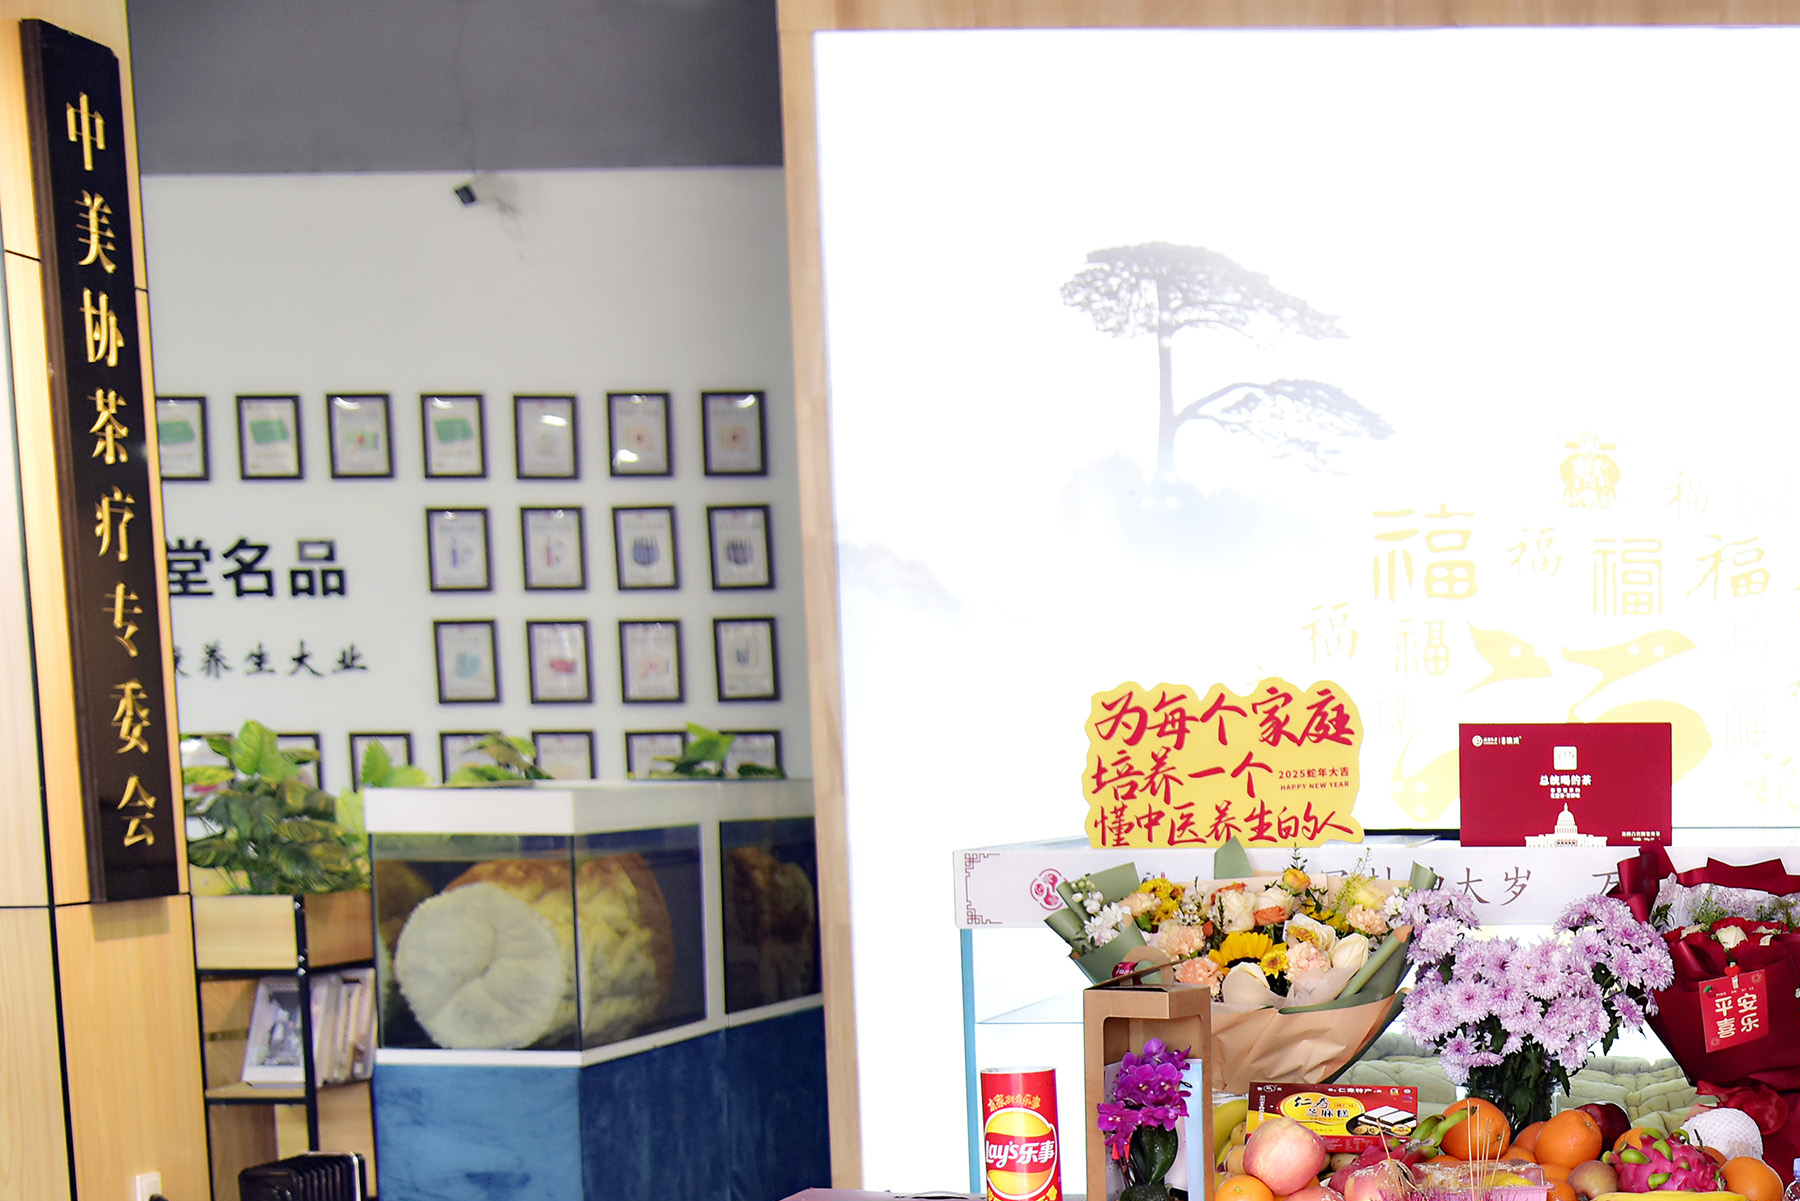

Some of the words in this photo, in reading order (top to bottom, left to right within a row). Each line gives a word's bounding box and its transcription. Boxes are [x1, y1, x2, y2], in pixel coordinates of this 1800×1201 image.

[66, 91, 157, 848] 中美协茶疗专委会
[1094, 686, 1355, 750] 为每个家庭
[1091, 747, 1274, 804] 培养一个
[1278, 766, 1350, 780] 2025蛇年大吉
[1280, 782, 1307, 792] HAPPY
[1309, 781, 1328, 790] NEW
[1329, 780, 1351, 789] YEAR
[1093, 798, 1355, 848] 懂中医养生的人
[1715, 992, 1758, 1017] 平安
[1716, 1012, 1759, 1039] 喜乐
